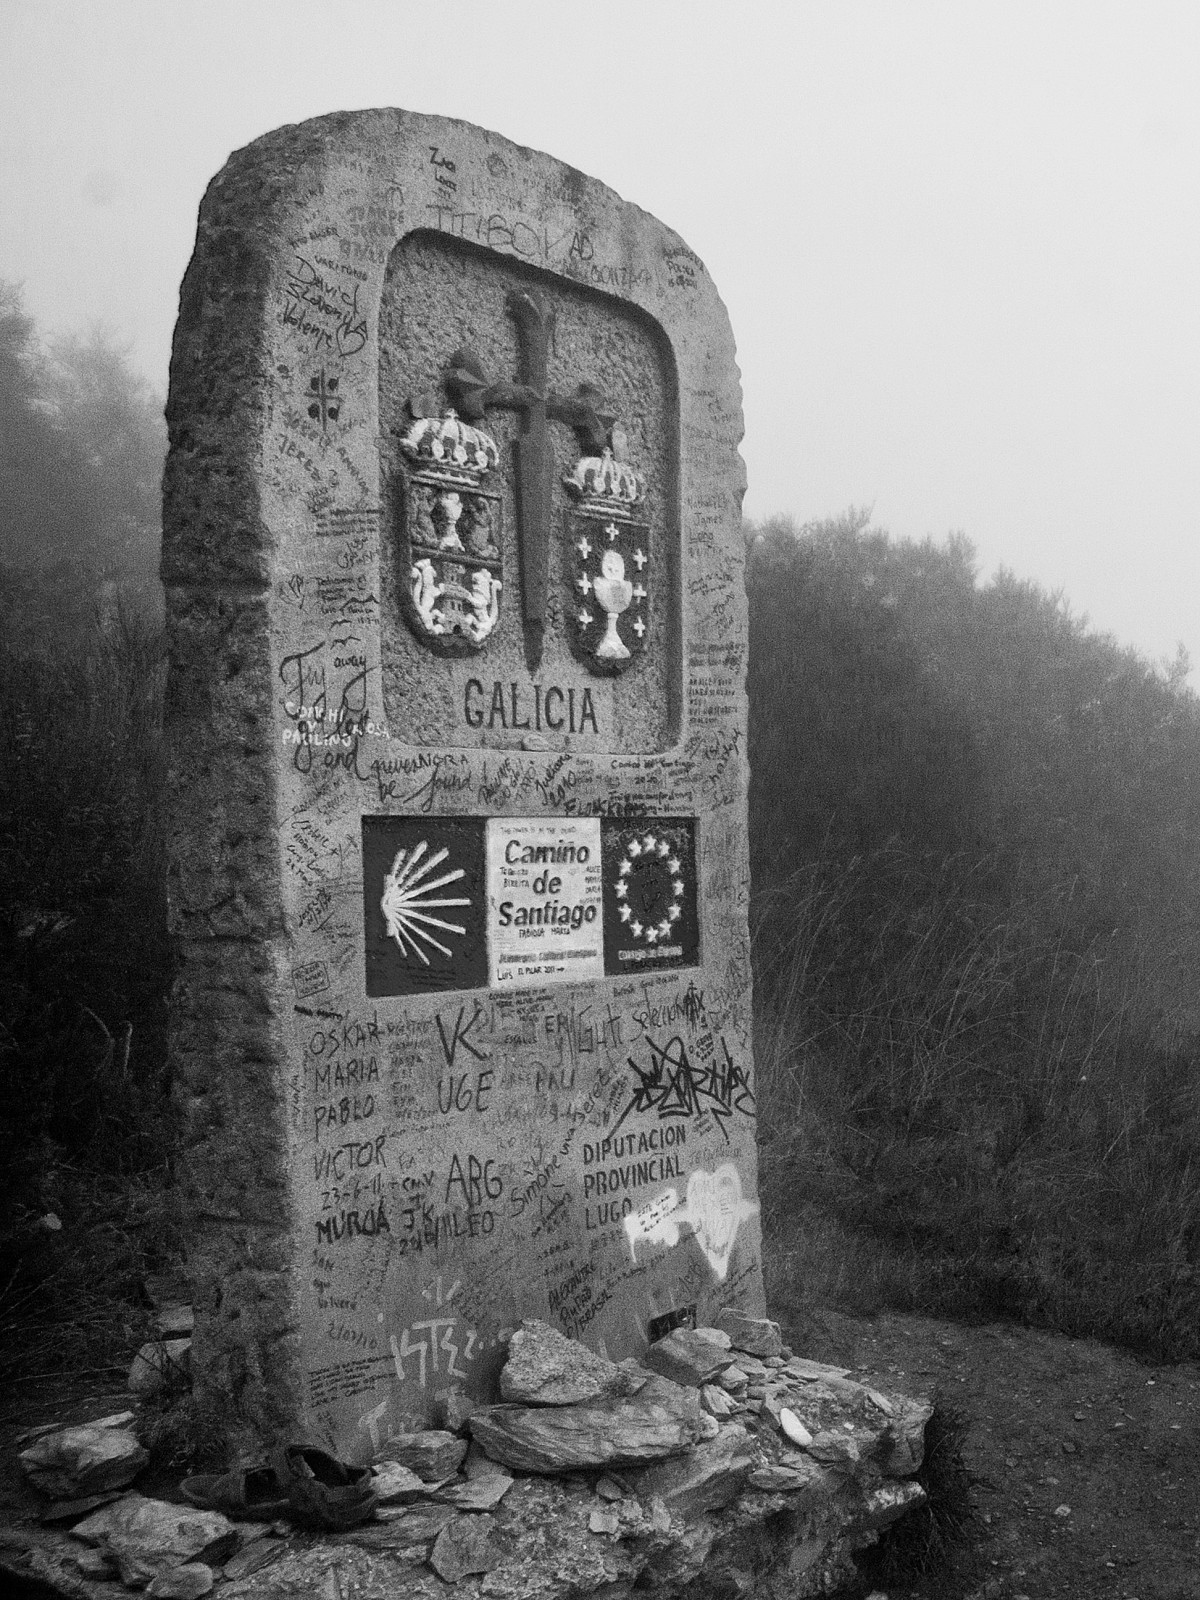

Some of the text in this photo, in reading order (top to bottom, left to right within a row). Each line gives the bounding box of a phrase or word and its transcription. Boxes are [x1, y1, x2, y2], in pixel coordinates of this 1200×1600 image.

[464, 678, 599, 734] GALICIA
[532, 869, 562, 894] de
[499, 899, 597, 930] Santiago
[310, 1023, 381, 1057] OSKAR
[315, 1057, 379, 1092] MARIA
[314, 1094, 374, 1143] PABLO
[315, 1136, 388, 1181] VICTOR
[583, 1124, 686, 1166] DIPUTACION
[583, 1155, 685, 1199] PROVINCIAL
[584, 1197, 633, 1231] LUGO
